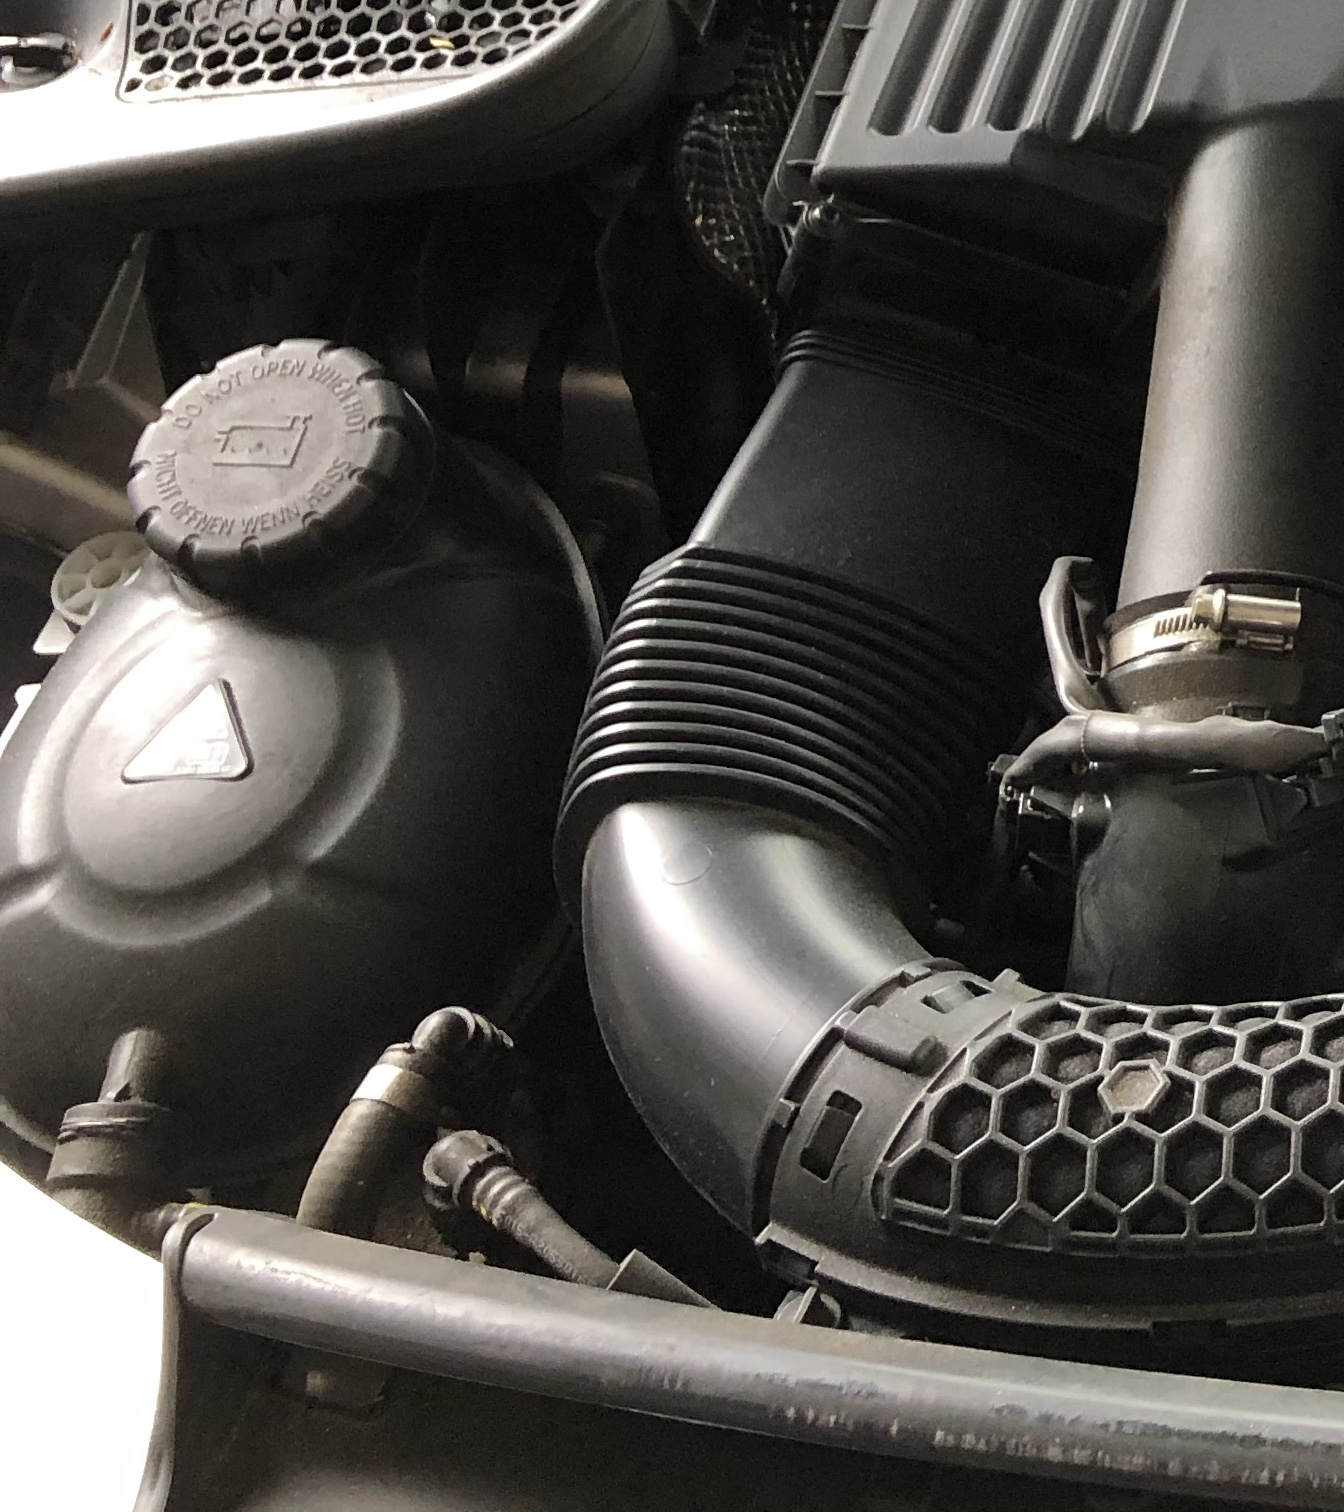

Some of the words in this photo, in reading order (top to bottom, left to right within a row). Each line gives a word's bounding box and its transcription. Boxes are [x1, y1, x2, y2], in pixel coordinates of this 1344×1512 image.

[171, 403, 203, 431] DO
[251, 358, 307, 382] OPEN
[307, 362, 358, 403] WHEN
[343, 399, 366, 436] HOT
[154, 449, 183, 502] NICHT
[242, 501, 301, 536] WENN
[308, 457, 352, 508] HEISS
